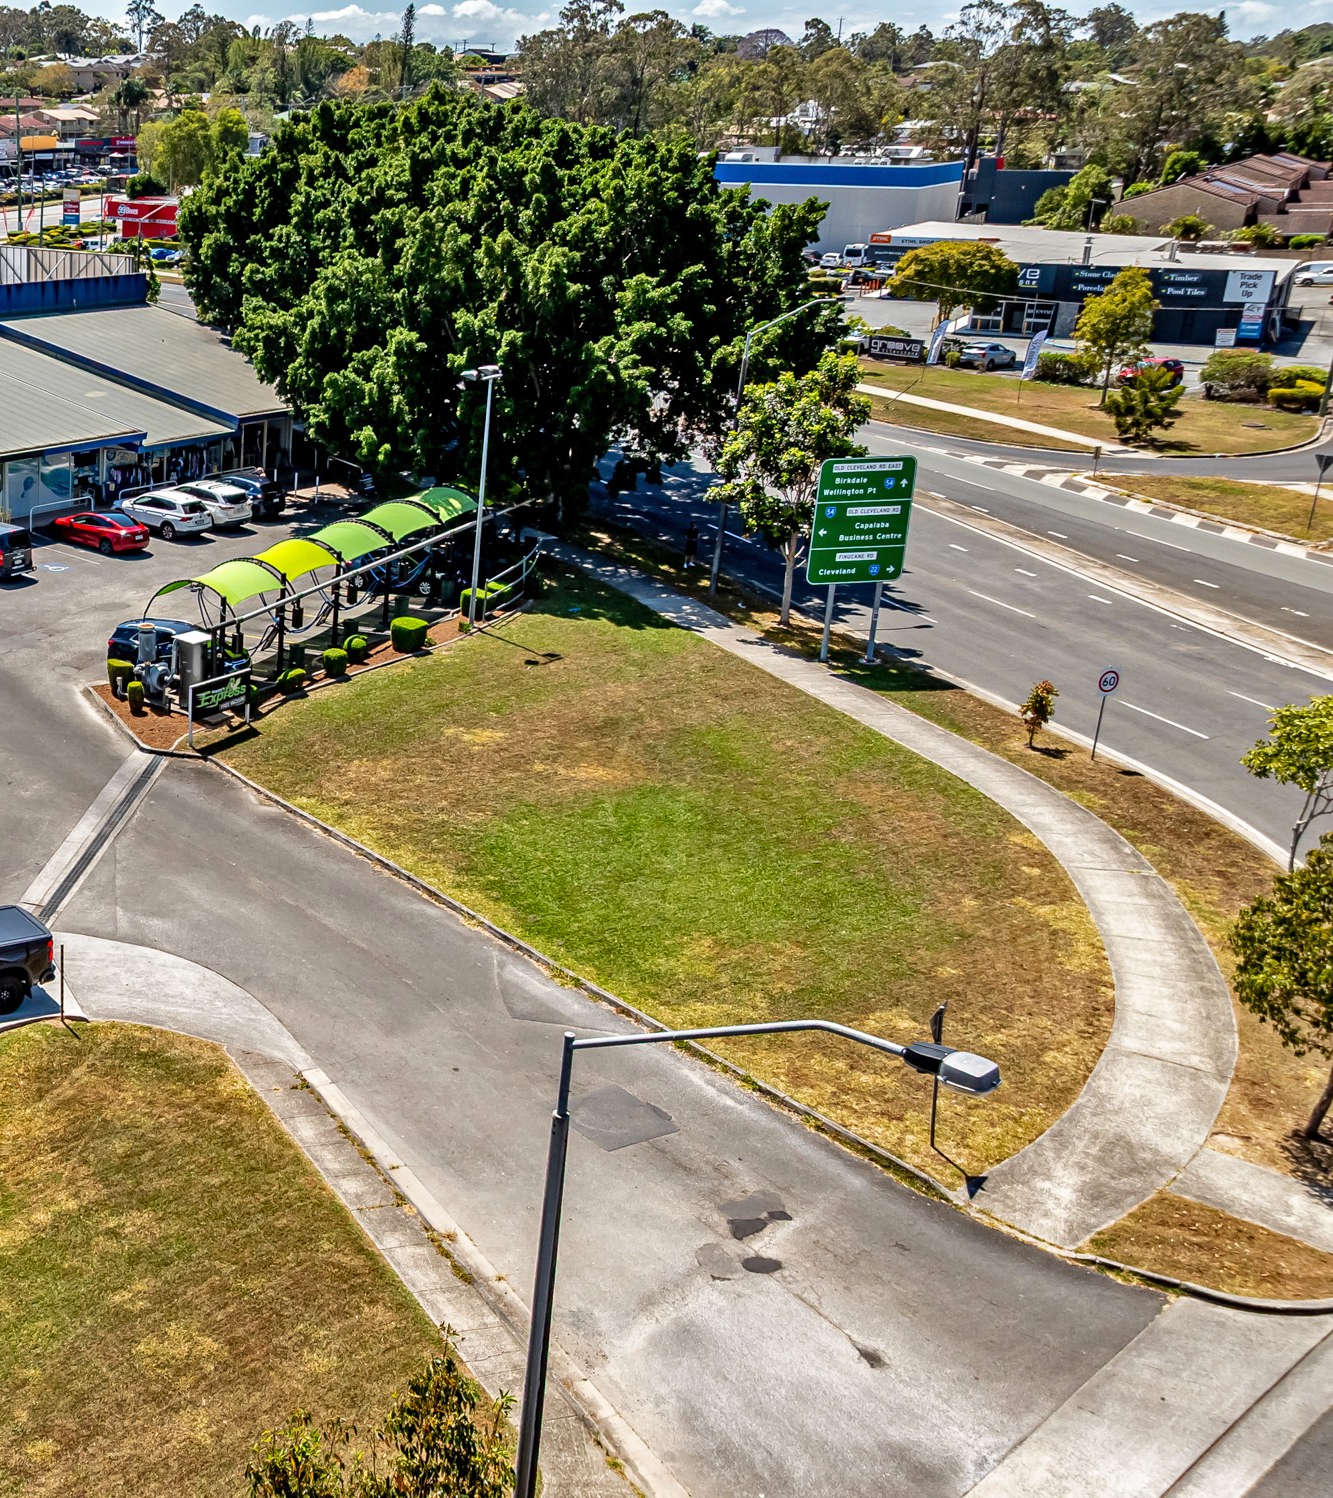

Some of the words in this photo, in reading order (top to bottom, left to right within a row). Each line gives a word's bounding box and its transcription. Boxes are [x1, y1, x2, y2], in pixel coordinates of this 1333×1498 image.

[1079, 270, 1101, 279] Stone
[1169, 273, 1199, 282] Timber
[1240, 272, 1263, 281] Trade
[1239, 281, 1258, 289] Pick
[1166, 287, 1184, 295] Pool
[1186, 288, 1205, 296] Tiles
[1241, 290, 1253, 298] Up
[871, 339, 920, 352] groove
[823, 488, 864, 496] Wellington
[818, 568, 857, 576] Cleveland
[1102, 676, 1116, 687] 60
[196, 684, 247, 709] Express
